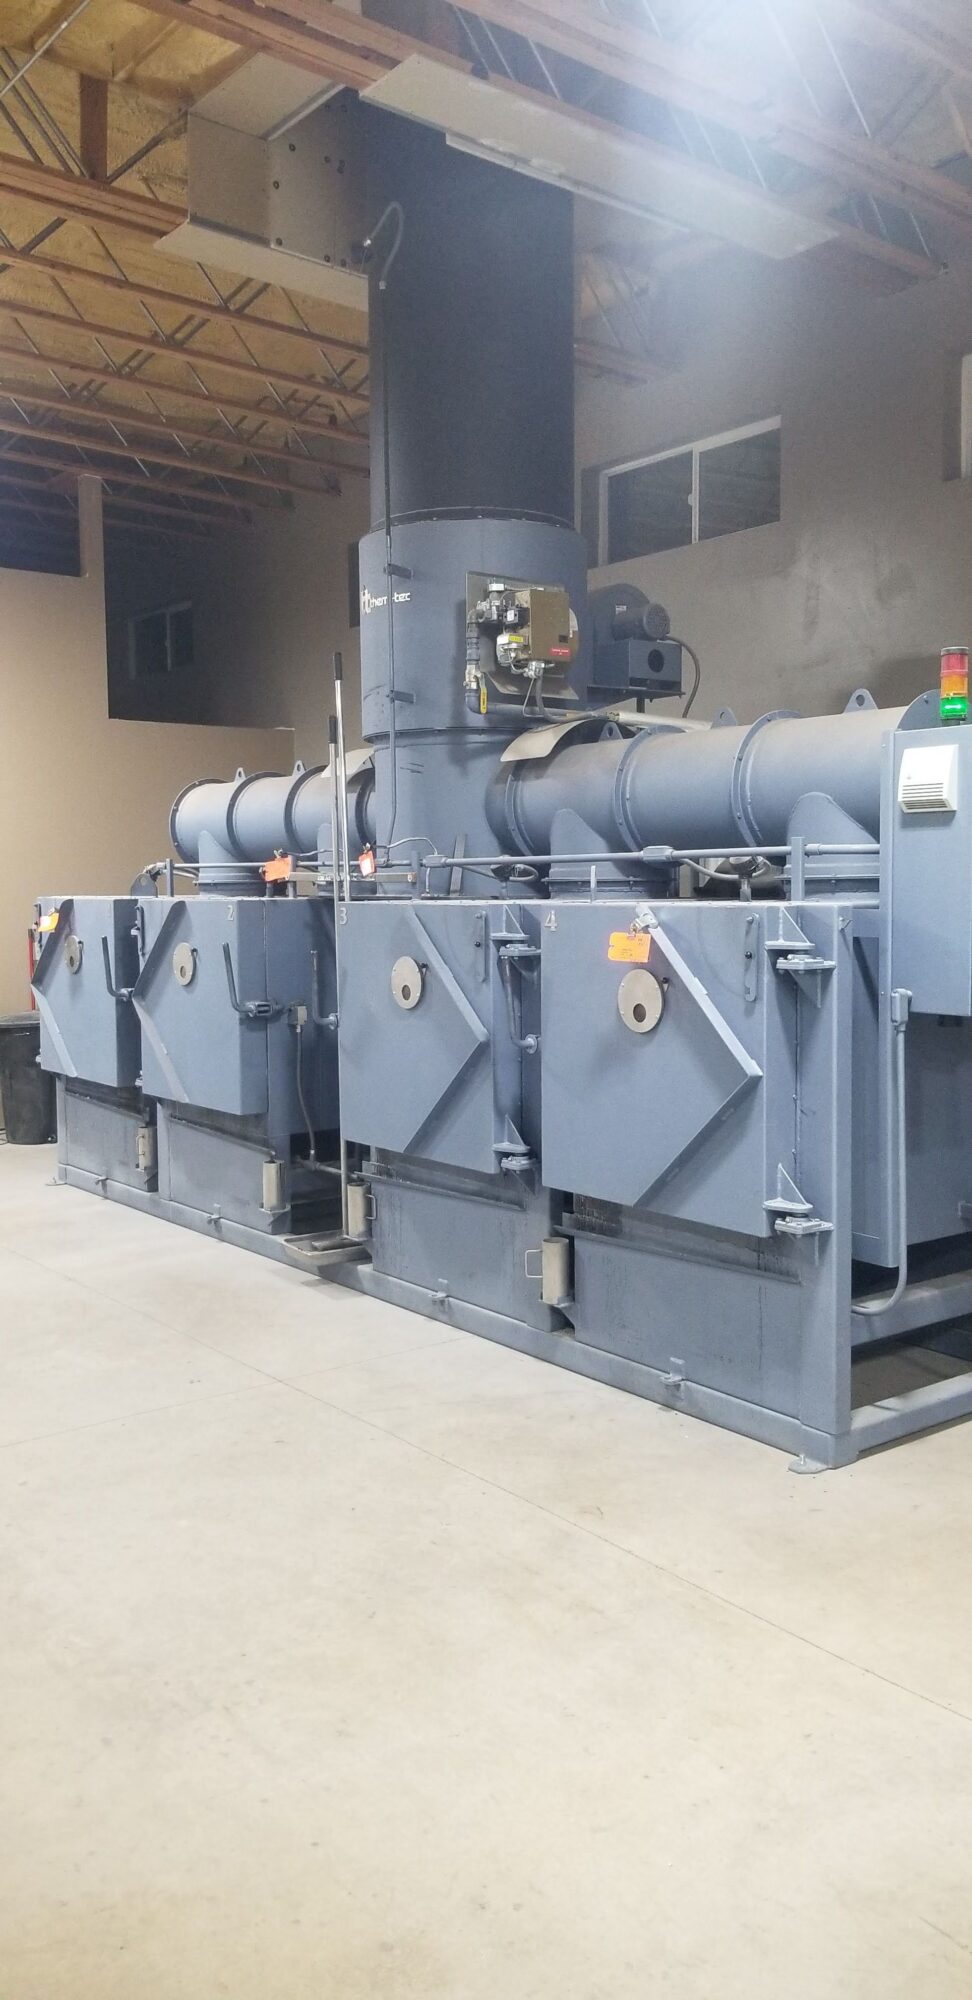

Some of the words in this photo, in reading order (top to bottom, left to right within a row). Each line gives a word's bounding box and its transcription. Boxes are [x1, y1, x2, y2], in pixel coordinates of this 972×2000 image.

[369, 592, 411, 608] ther-tec
[227, 904, 234, 921] 2
[339, 907, 348, 925] 3
[544, 911, 558, 931] 4
